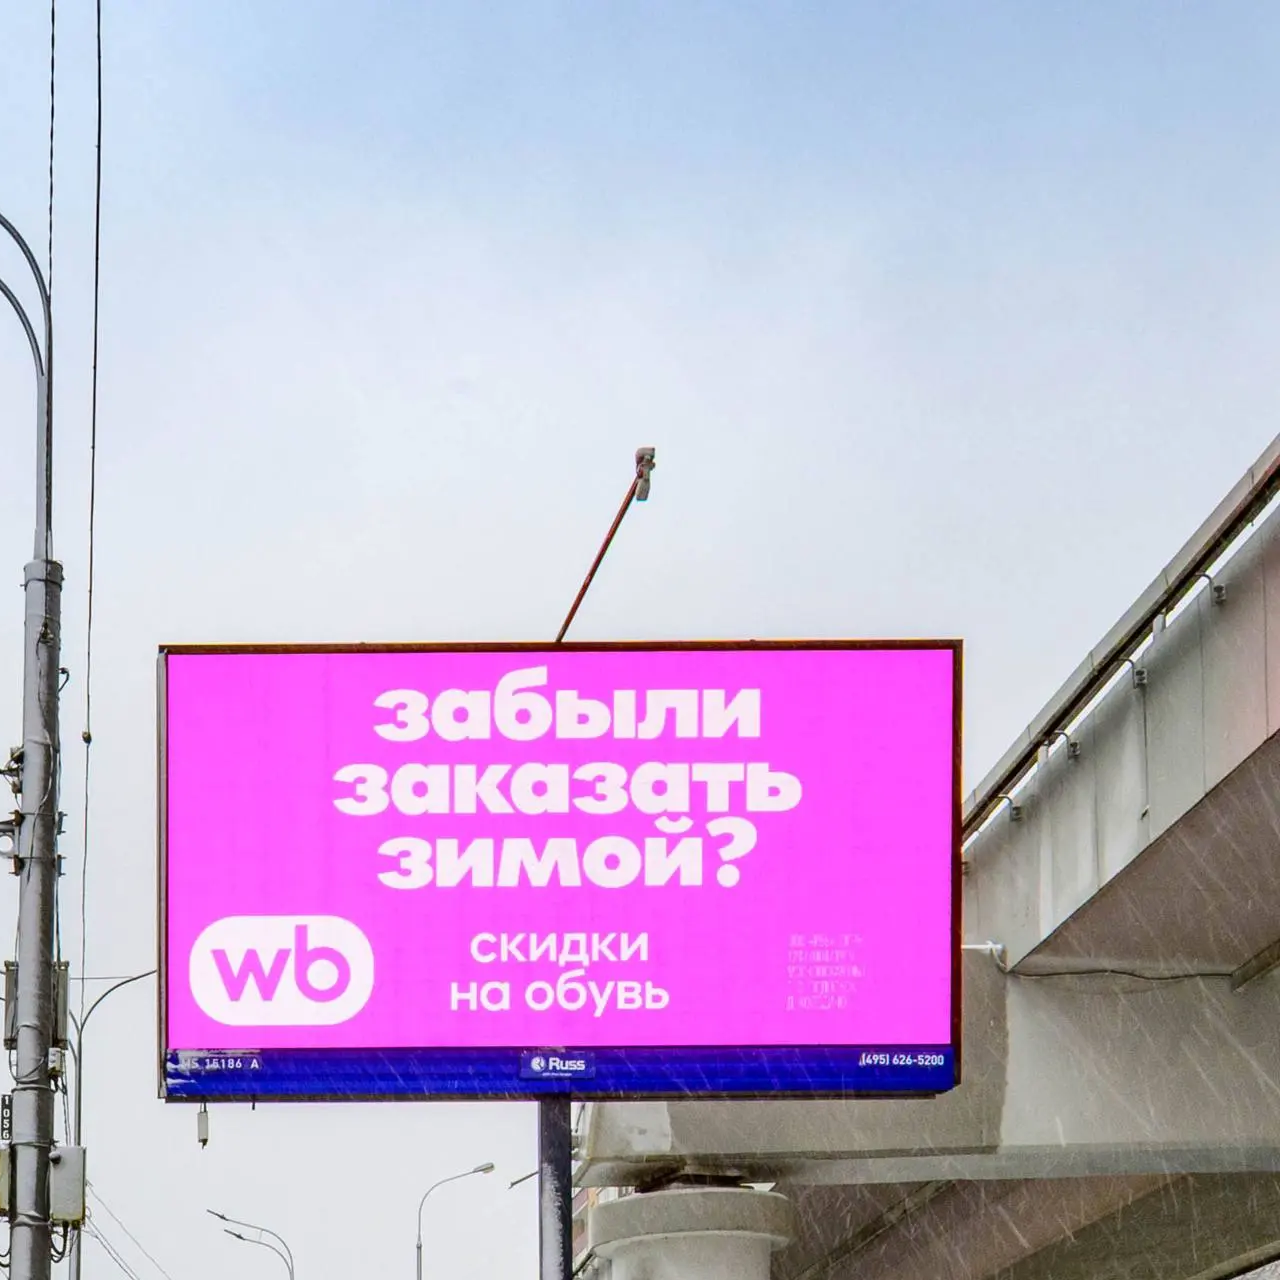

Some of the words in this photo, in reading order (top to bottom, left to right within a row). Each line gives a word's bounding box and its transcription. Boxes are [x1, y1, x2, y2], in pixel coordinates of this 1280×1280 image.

[373, 665, 761, 742] забыли
[332, 761, 803, 817] заказать
[376, 816, 758, 890] зимой?
[209, 923, 352, 1003] wb
[470, 932, 649, 967] скидки
[450, 980, 511, 1012] на
[524, 968, 670, 1017] обувь
[548, 1056, 586, 1071] Russ
[861, 1052, 890, 1066] (495)
[892, 1054, 945, 1066] 626-5200
[2, 1095, 11, 1140] 1056
